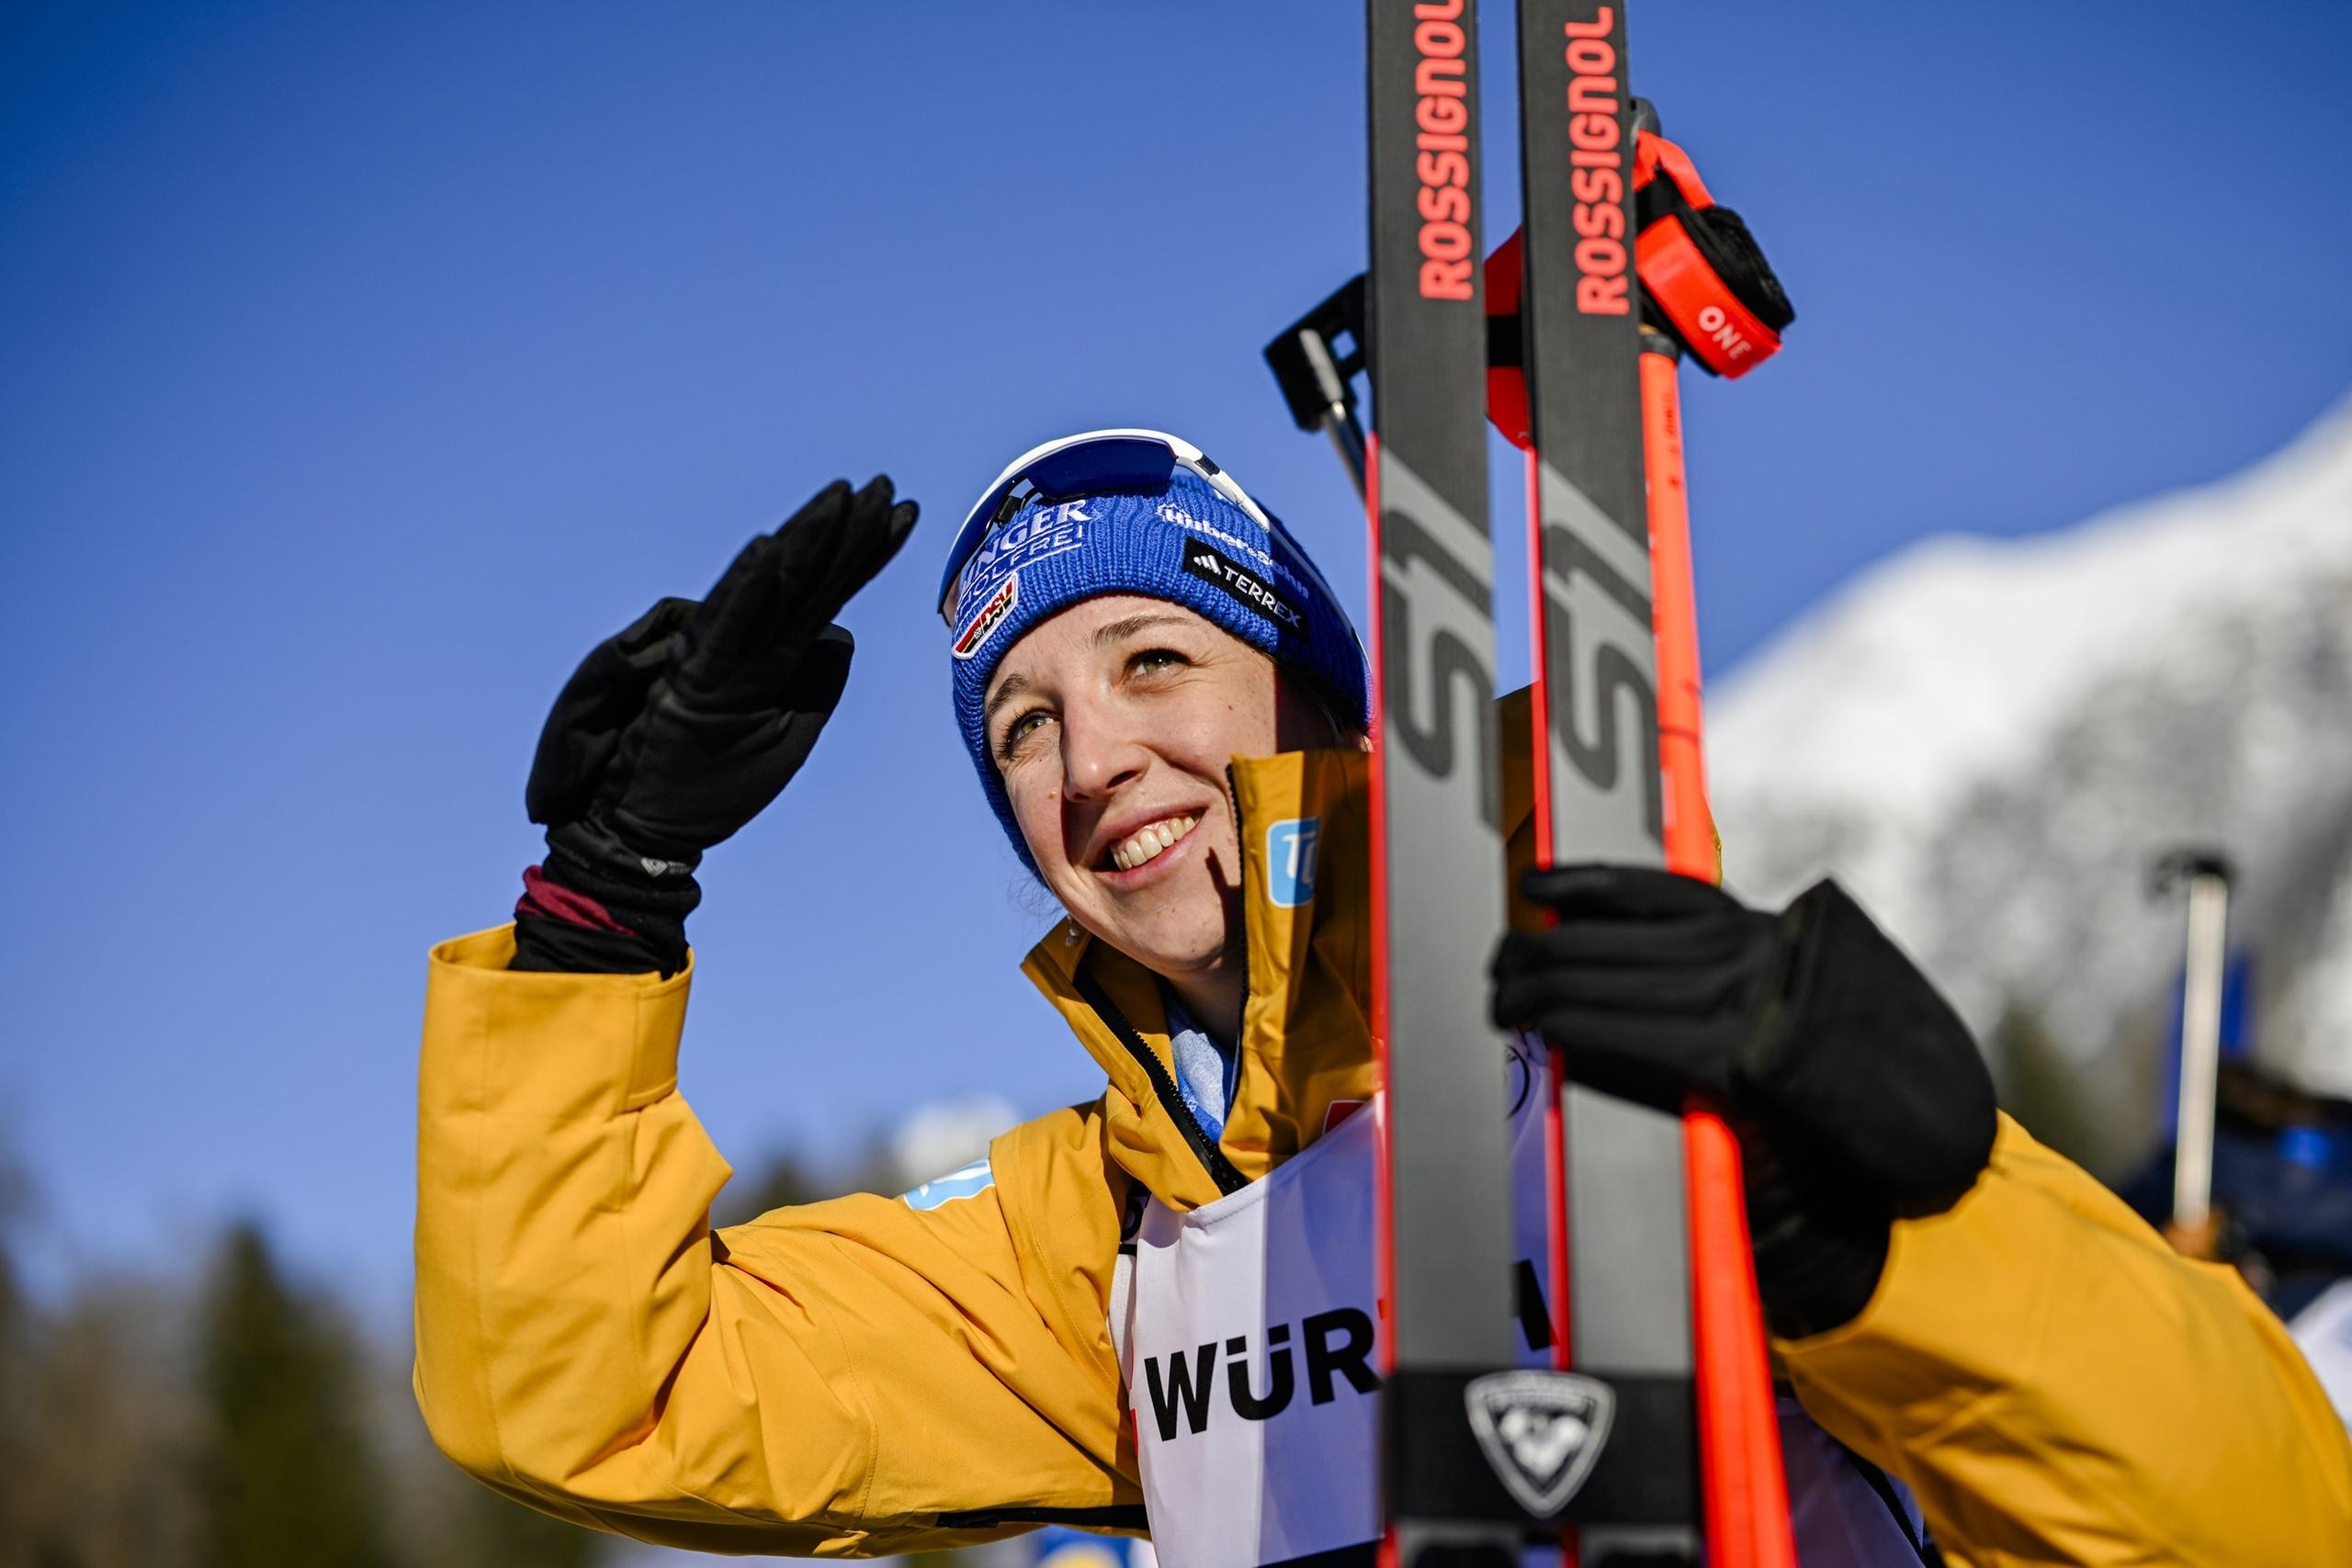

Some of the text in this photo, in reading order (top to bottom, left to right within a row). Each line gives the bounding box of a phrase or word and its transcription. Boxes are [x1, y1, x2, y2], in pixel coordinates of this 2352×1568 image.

[1413, 0, 1474, 300] ROSSIGNOL
[1565, 6, 1631, 317] ROSSIGNOL
[1698, 305, 1751, 361] ONE
[958, 525, 1083, 619] HOLFREI
[964, 499, 1092, 591] INGER
[1224, 565, 1302, 628] TERREX
